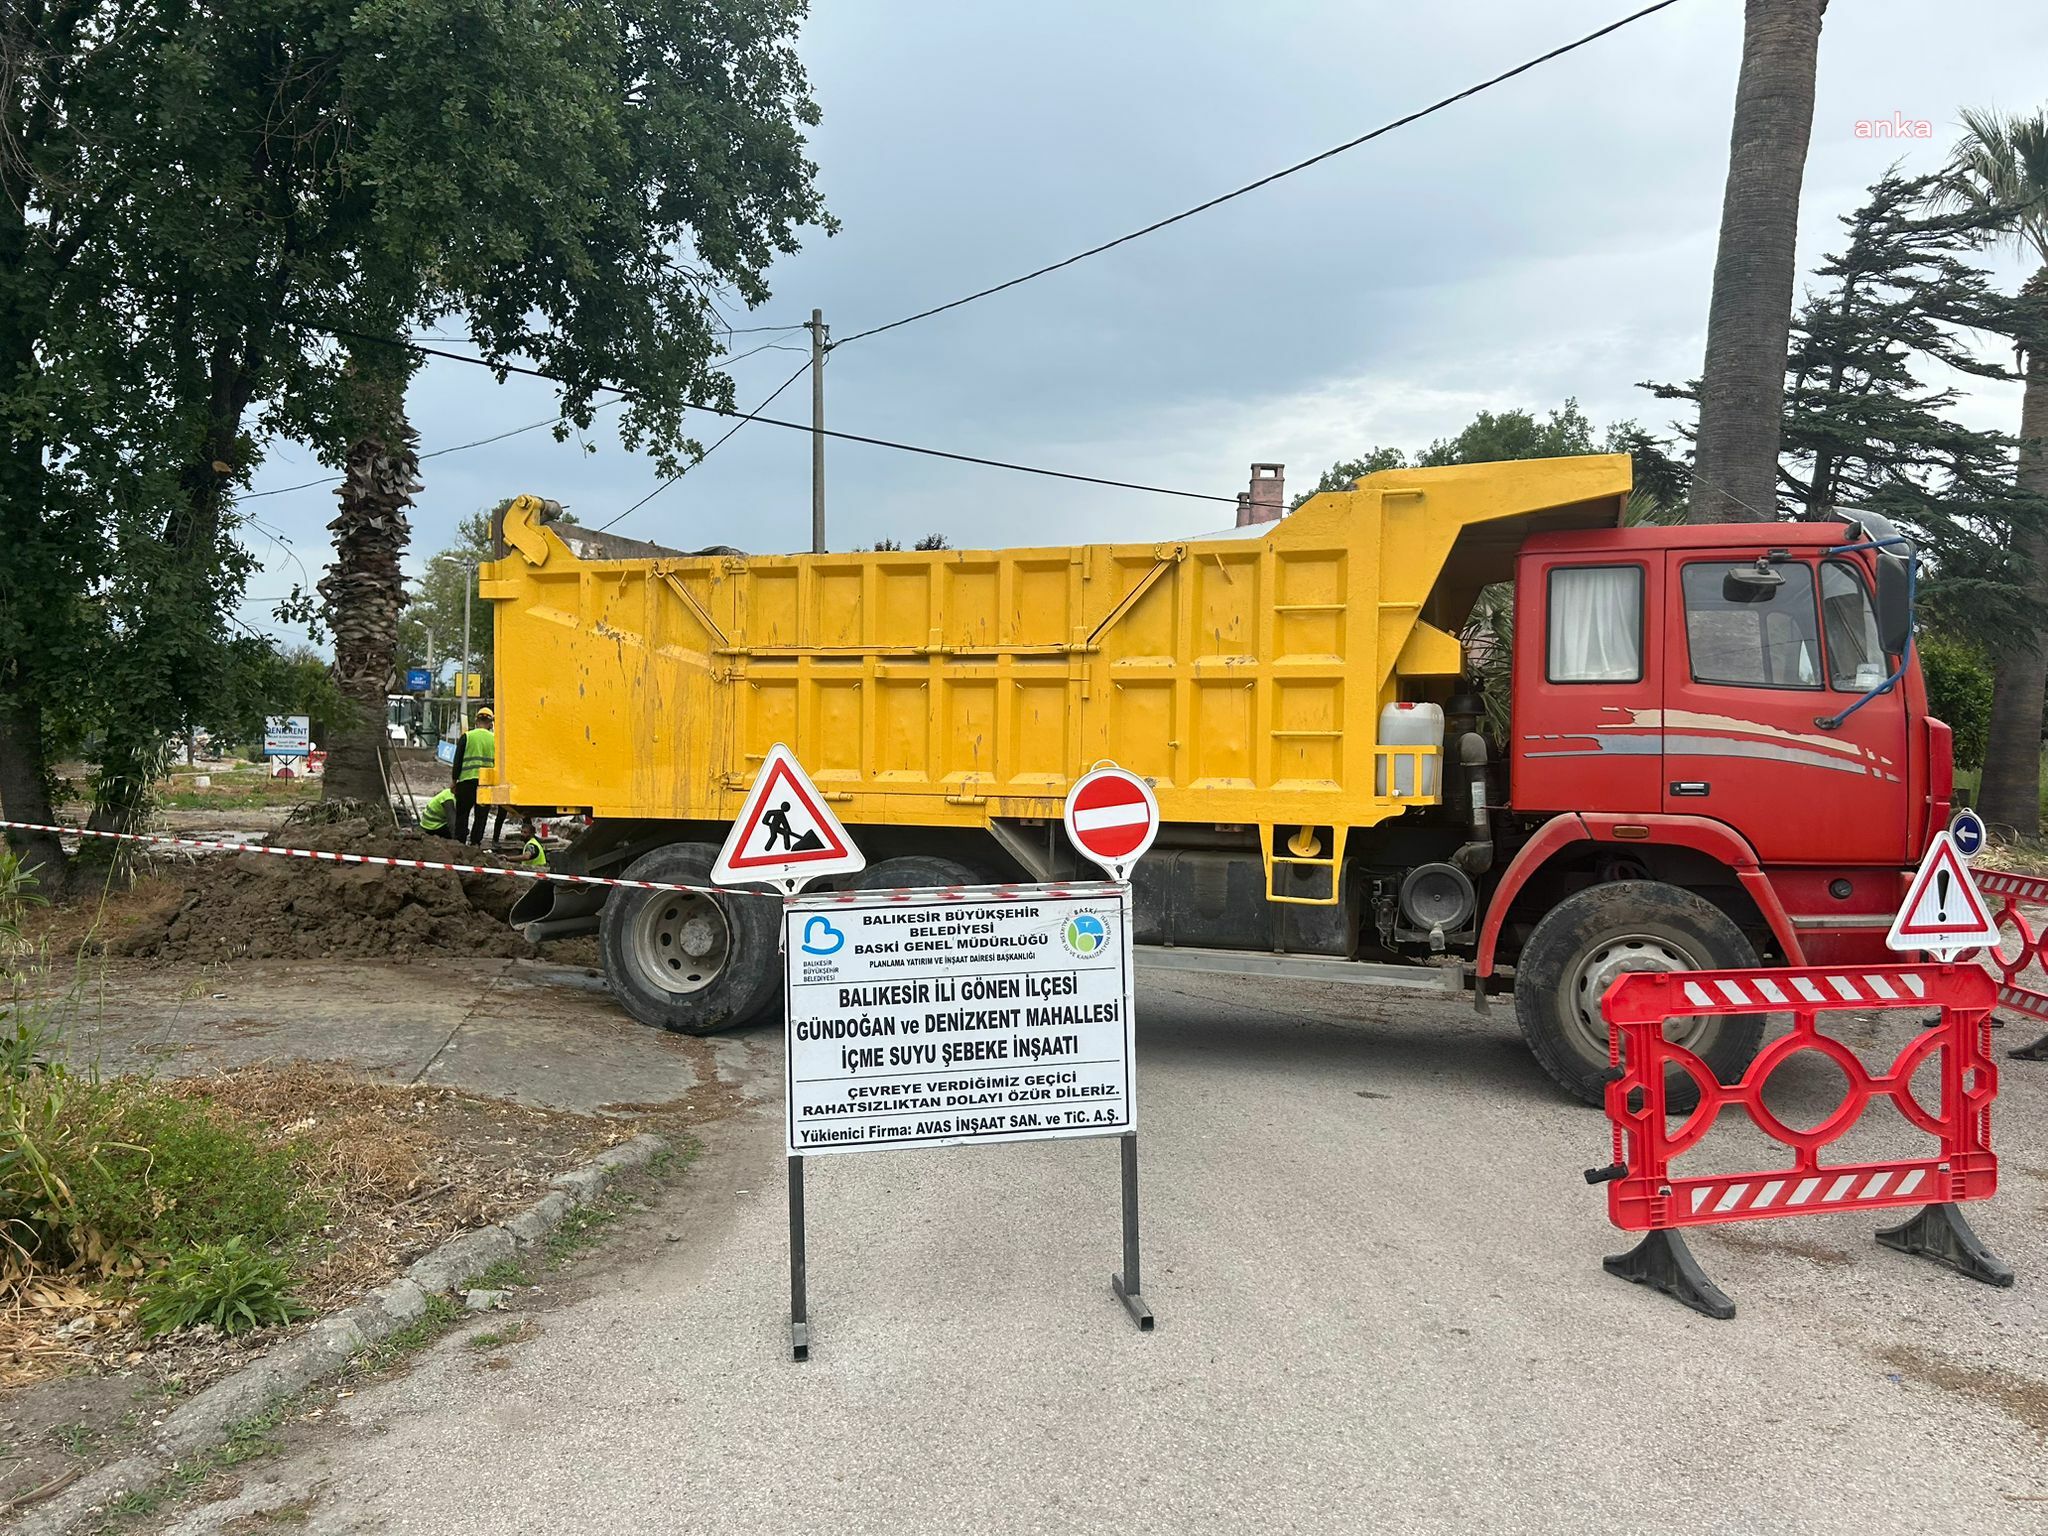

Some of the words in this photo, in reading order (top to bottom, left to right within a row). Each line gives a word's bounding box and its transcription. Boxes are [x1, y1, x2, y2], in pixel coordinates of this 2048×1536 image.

[862, 911, 941, 925] BALIKESİR
[945, 906, 1039, 921] BÜYÜKŞEHİR
[910, 921, 994, 937] BELEDİYESİ
[854, 940, 899, 954] BASKİ
[904, 940, 953, 952] GENEL
[957, 933, 1048, 949] MÜDÜRLÜĞÜ
[803, 959, 832, 967] BALIKESİR
[869, 959, 905, 968] PLANLAMA
[906, 957, 933, 966] YATIRIM
[944, 955, 968, 965] İNŞAAT
[970, 953, 995, 962] DAİRESİ
[997, 950, 1036, 962] BAŞKANLIĞI
[803, 967, 839, 975] BÜYÜKŞEHİR
[803, 974, 835, 982] BELEDİYESİ
[839, 980, 930, 1008] BALIKESİR
[935, 978, 955, 1002] İLİ
[961, 977, 1020, 1001] GÖNEN
[1025, 971, 1078, 1001] İLÇESİ
[796, 1013, 896, 1041] GÜNDOĞAN
[901, 1019, 920, 1034] ve
[925, 1007, 1021, 1033] DENİZKENT
[1026, 998, 1119, 1027] MAHALLESİ
[842, 1045, 884, 1073] İÇME
[889, 1044, 936, 1066] SUYU
[942, 1039, 1008, 1067] ŞEBEKE
[1013, 1034, 1078, 1061] İNŞAATI
[848, 1083, 922, 1100] ÇEVREYE
[927, 1075, 1020, 1092] VERDİĞİMİZ
[1024, 1071, 1077, 1086] GEÇİCİ
[802, 1097, 941, 1116] RAHATSIZLIKTAN
[946, 1093, 1003, 1106] DOLAYI
[1008, 1088, 1051, 1102] ÖZÜR
[1056, 1083, 1120, 1098] DİLERİZ.
[800, 1126, 865, 1143] Yüklenici
[869, 1125, 912, 1138] Firma:
[916, 1120, 951, 1135] AVAS
[956, 1116, 1006, 1135] İNŞAAT
[1010, 1113, 1042, 1128] SAN.
[1046, 1114, 1060, 1125] ve
[1094, 1108, 1119, 1125] A.Ş.
